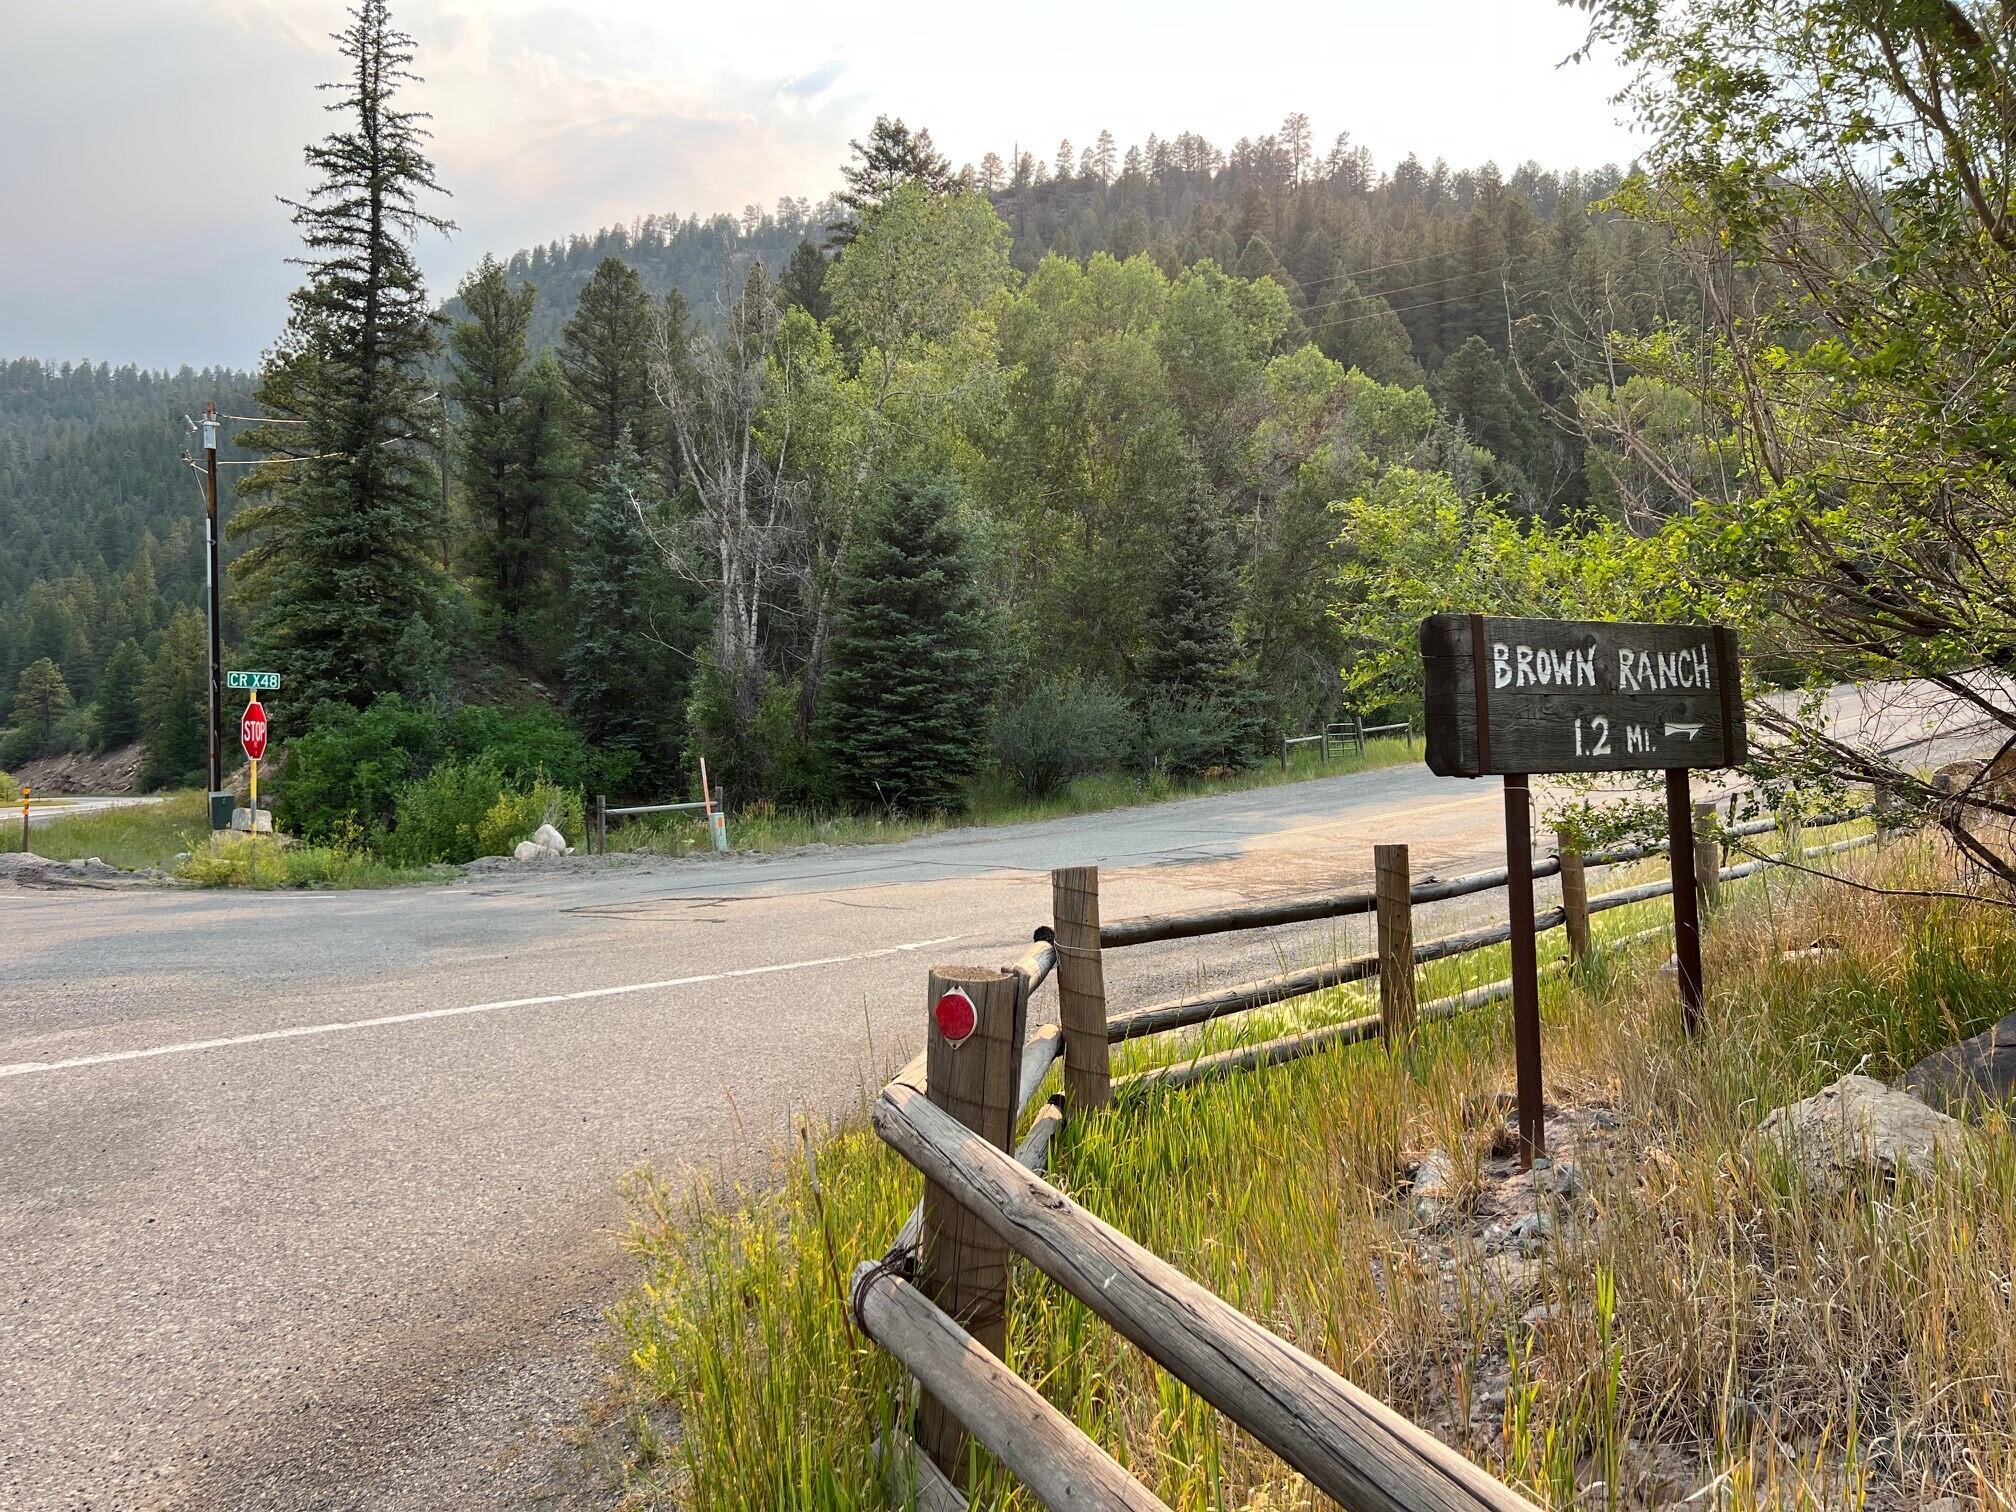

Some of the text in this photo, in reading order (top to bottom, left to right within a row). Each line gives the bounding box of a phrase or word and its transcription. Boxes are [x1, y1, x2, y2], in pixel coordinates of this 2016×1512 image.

[230, 673, 278, 688] CR X48
[1493, 642, 1711, 691] BROWN RANCH
[243, 720, 266, 742] STOP
[1574, 715, 1612, 757] 1.2
